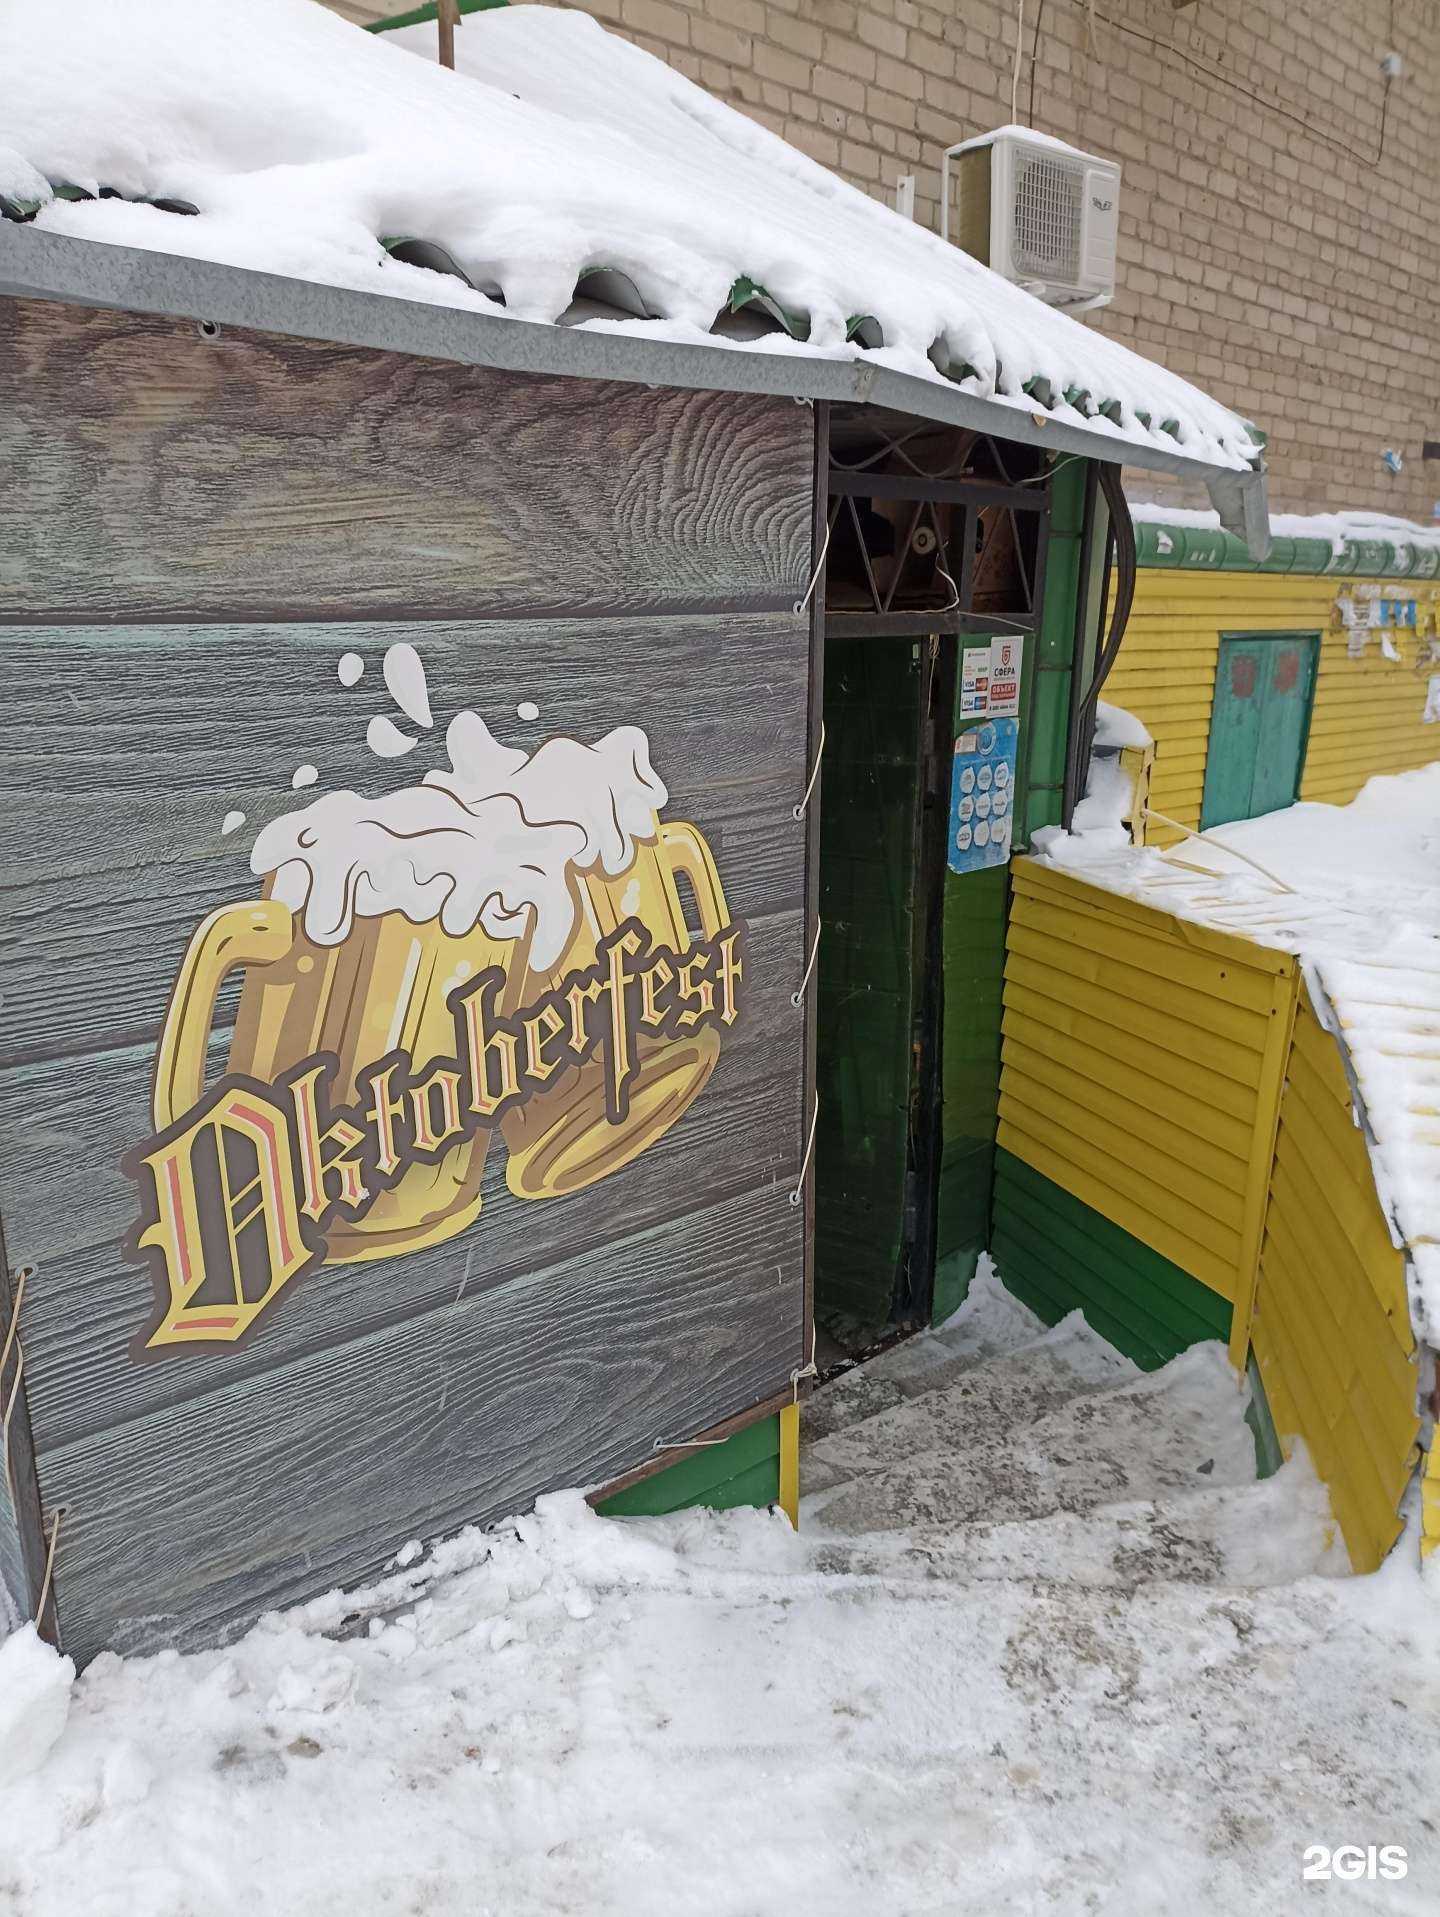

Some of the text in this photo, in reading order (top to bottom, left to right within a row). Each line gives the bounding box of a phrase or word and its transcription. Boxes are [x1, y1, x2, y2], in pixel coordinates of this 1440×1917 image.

[994, 667, 1015, 677] СФЕРА
[992, 684, 1015, 693] ОБЪЕКТ
[136, 927, 745, 1349] Oktoberfest
